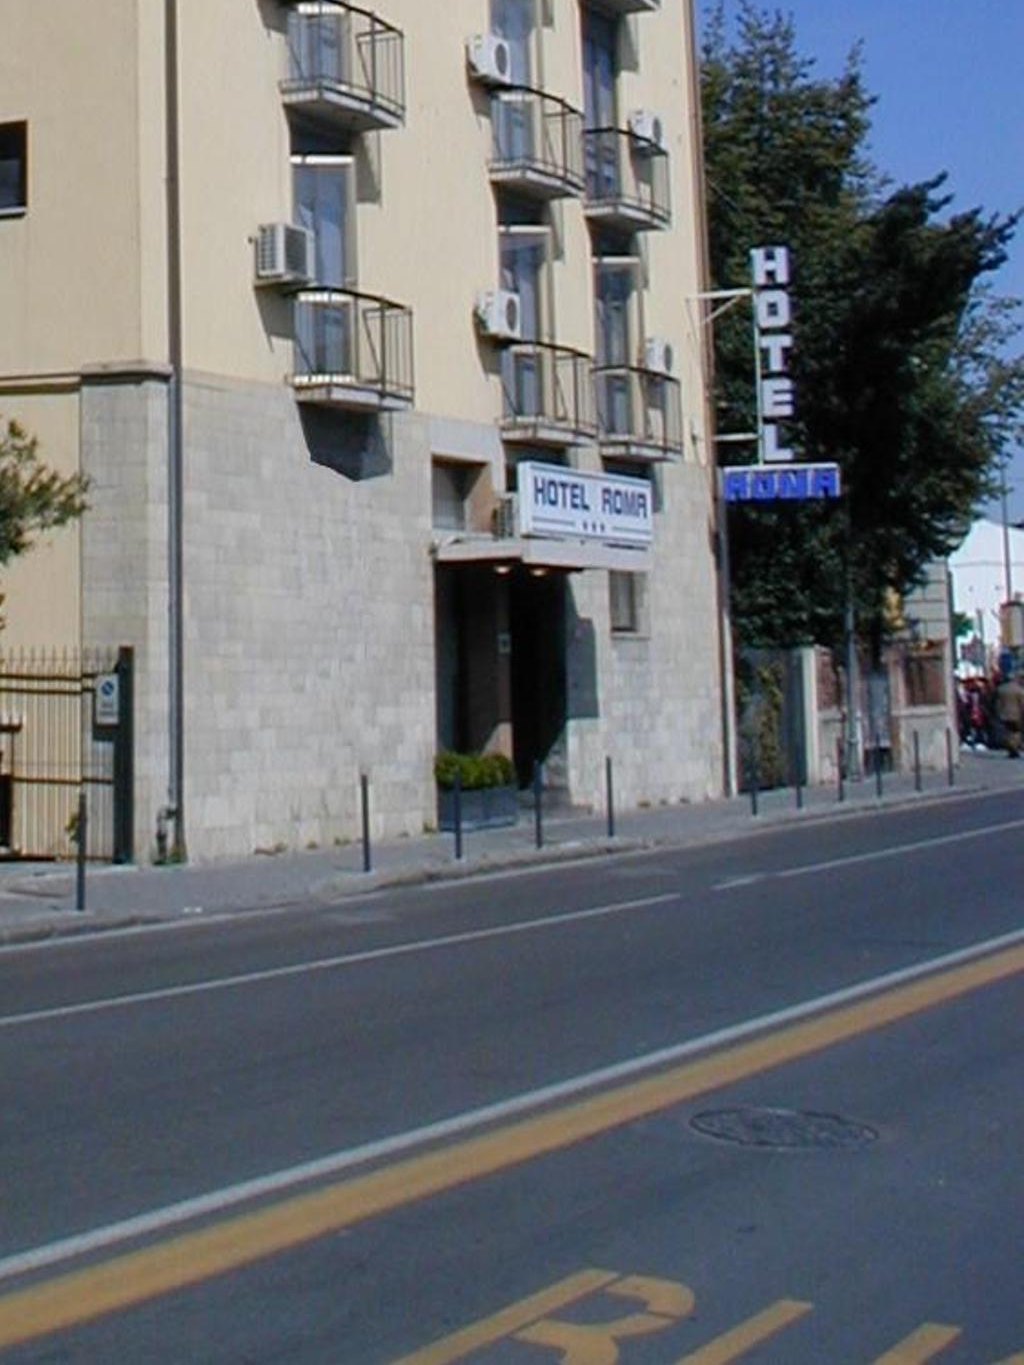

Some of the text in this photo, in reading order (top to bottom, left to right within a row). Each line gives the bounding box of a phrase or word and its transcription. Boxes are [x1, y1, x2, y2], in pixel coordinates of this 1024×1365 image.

[750, 246, 794, 461] HOTEL
[533, 476, 648, 519] HOTEL ROMA
